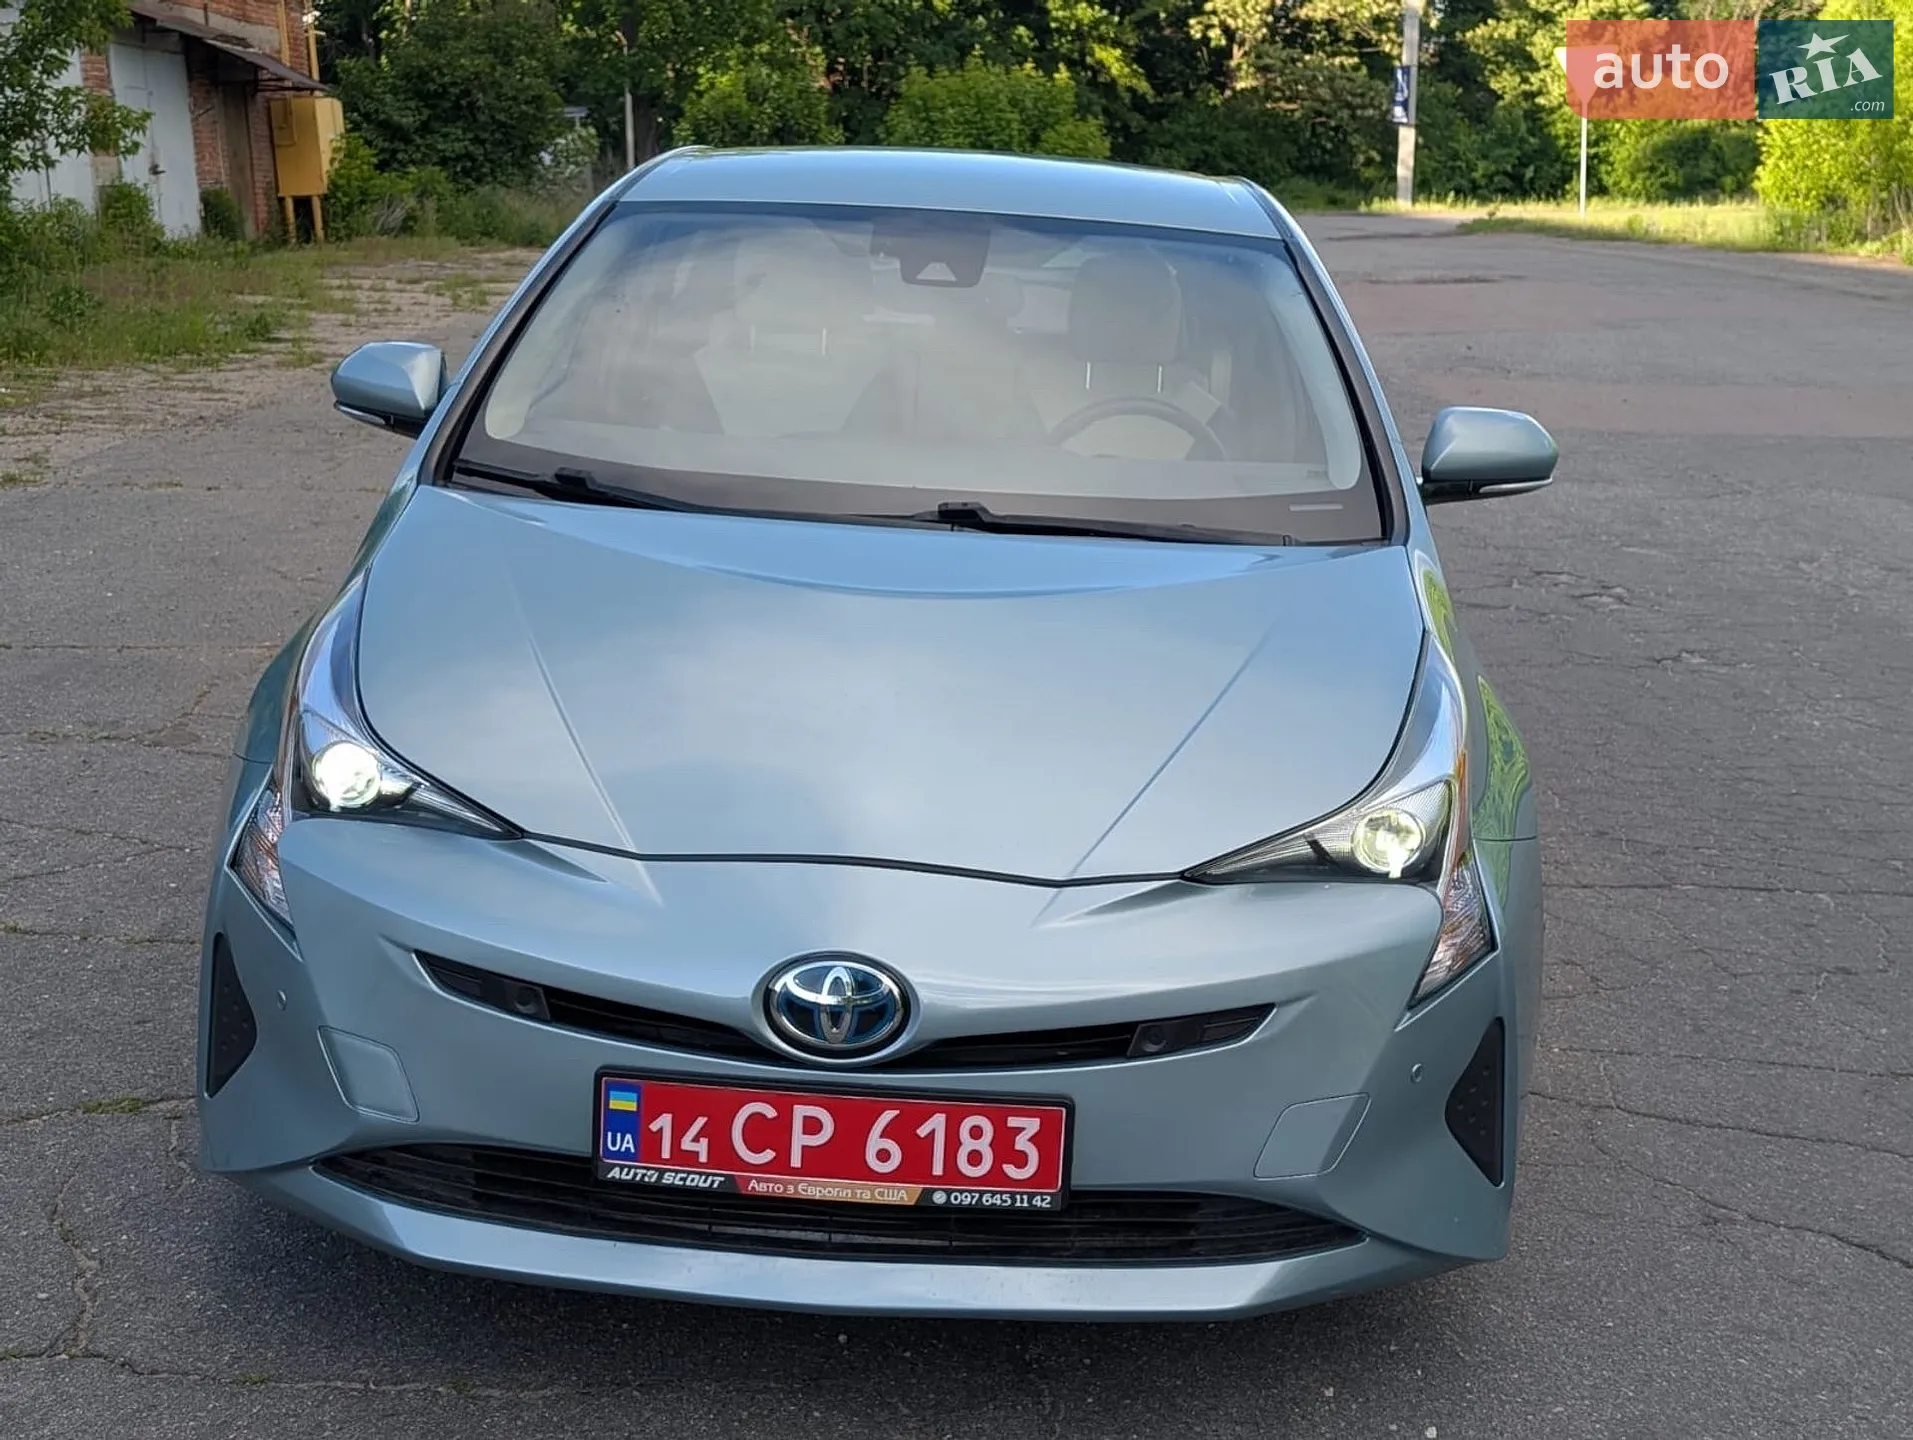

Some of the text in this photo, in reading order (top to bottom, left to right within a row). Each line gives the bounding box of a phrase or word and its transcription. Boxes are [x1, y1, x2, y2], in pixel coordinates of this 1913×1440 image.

[606, 1132, 636, 1155] UA
[648, 1101, 1041, 1181] 14 CP 6183
[607, 1166, 726, 1189] AUTO SCOUT
[748, 1179, 784, 1194] Авто
[855, 1188, 872, 1200] та
[874, 1187, 909, 1201] США
[950, 1191, 1052, 1208] 097 645 11 42
